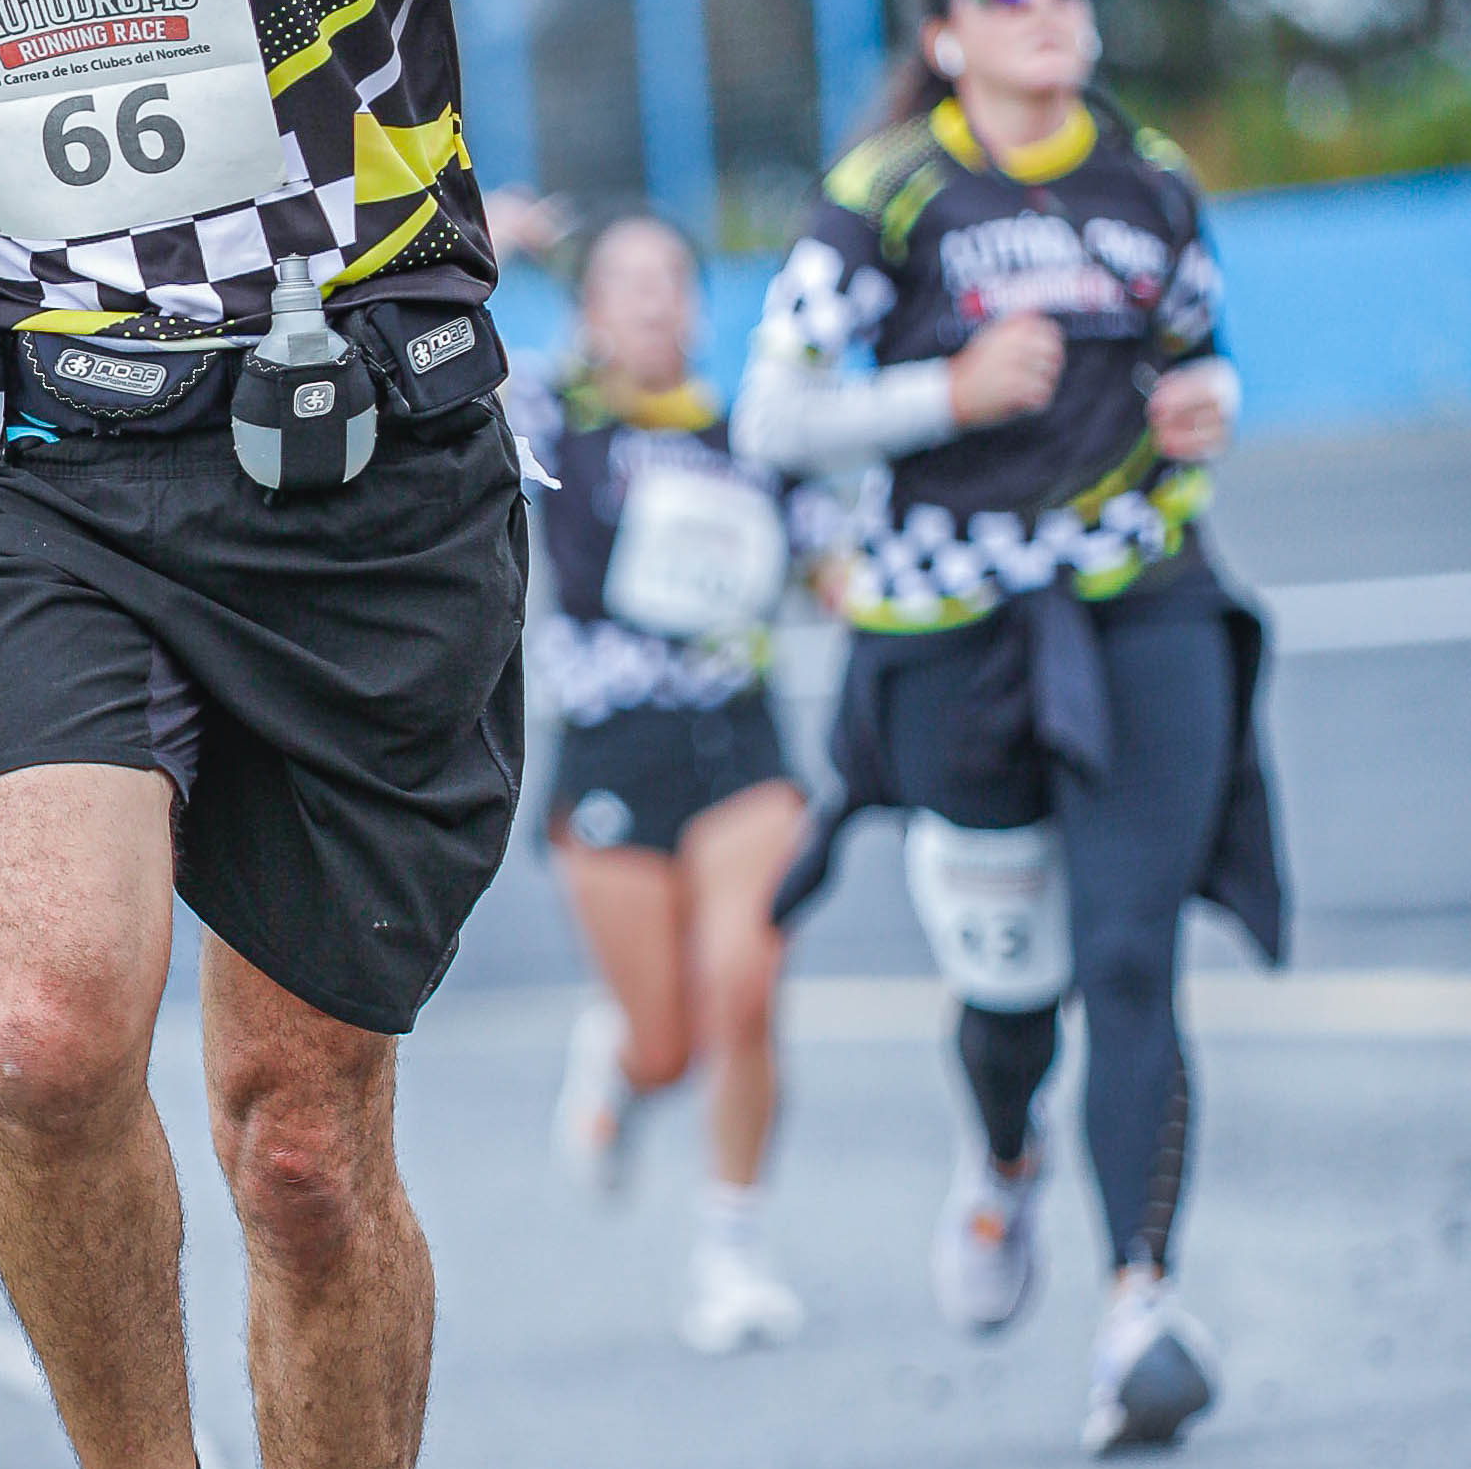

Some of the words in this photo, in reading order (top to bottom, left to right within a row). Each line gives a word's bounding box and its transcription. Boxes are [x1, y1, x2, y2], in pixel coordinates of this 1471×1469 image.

[16, 25, 108, 63] RUNNING
[112, 20, 166, 43] RACE
[4, 69, 49, 85] Carrera
[52, 66, 68, 77] de
[70, 63, 88, 74] los
[91, 56, 132, 71] Clubes
[135, 50, 154, 63] del
[156, 43, 211, 60] Noroeste
[42, 83, 185, 187] 66
